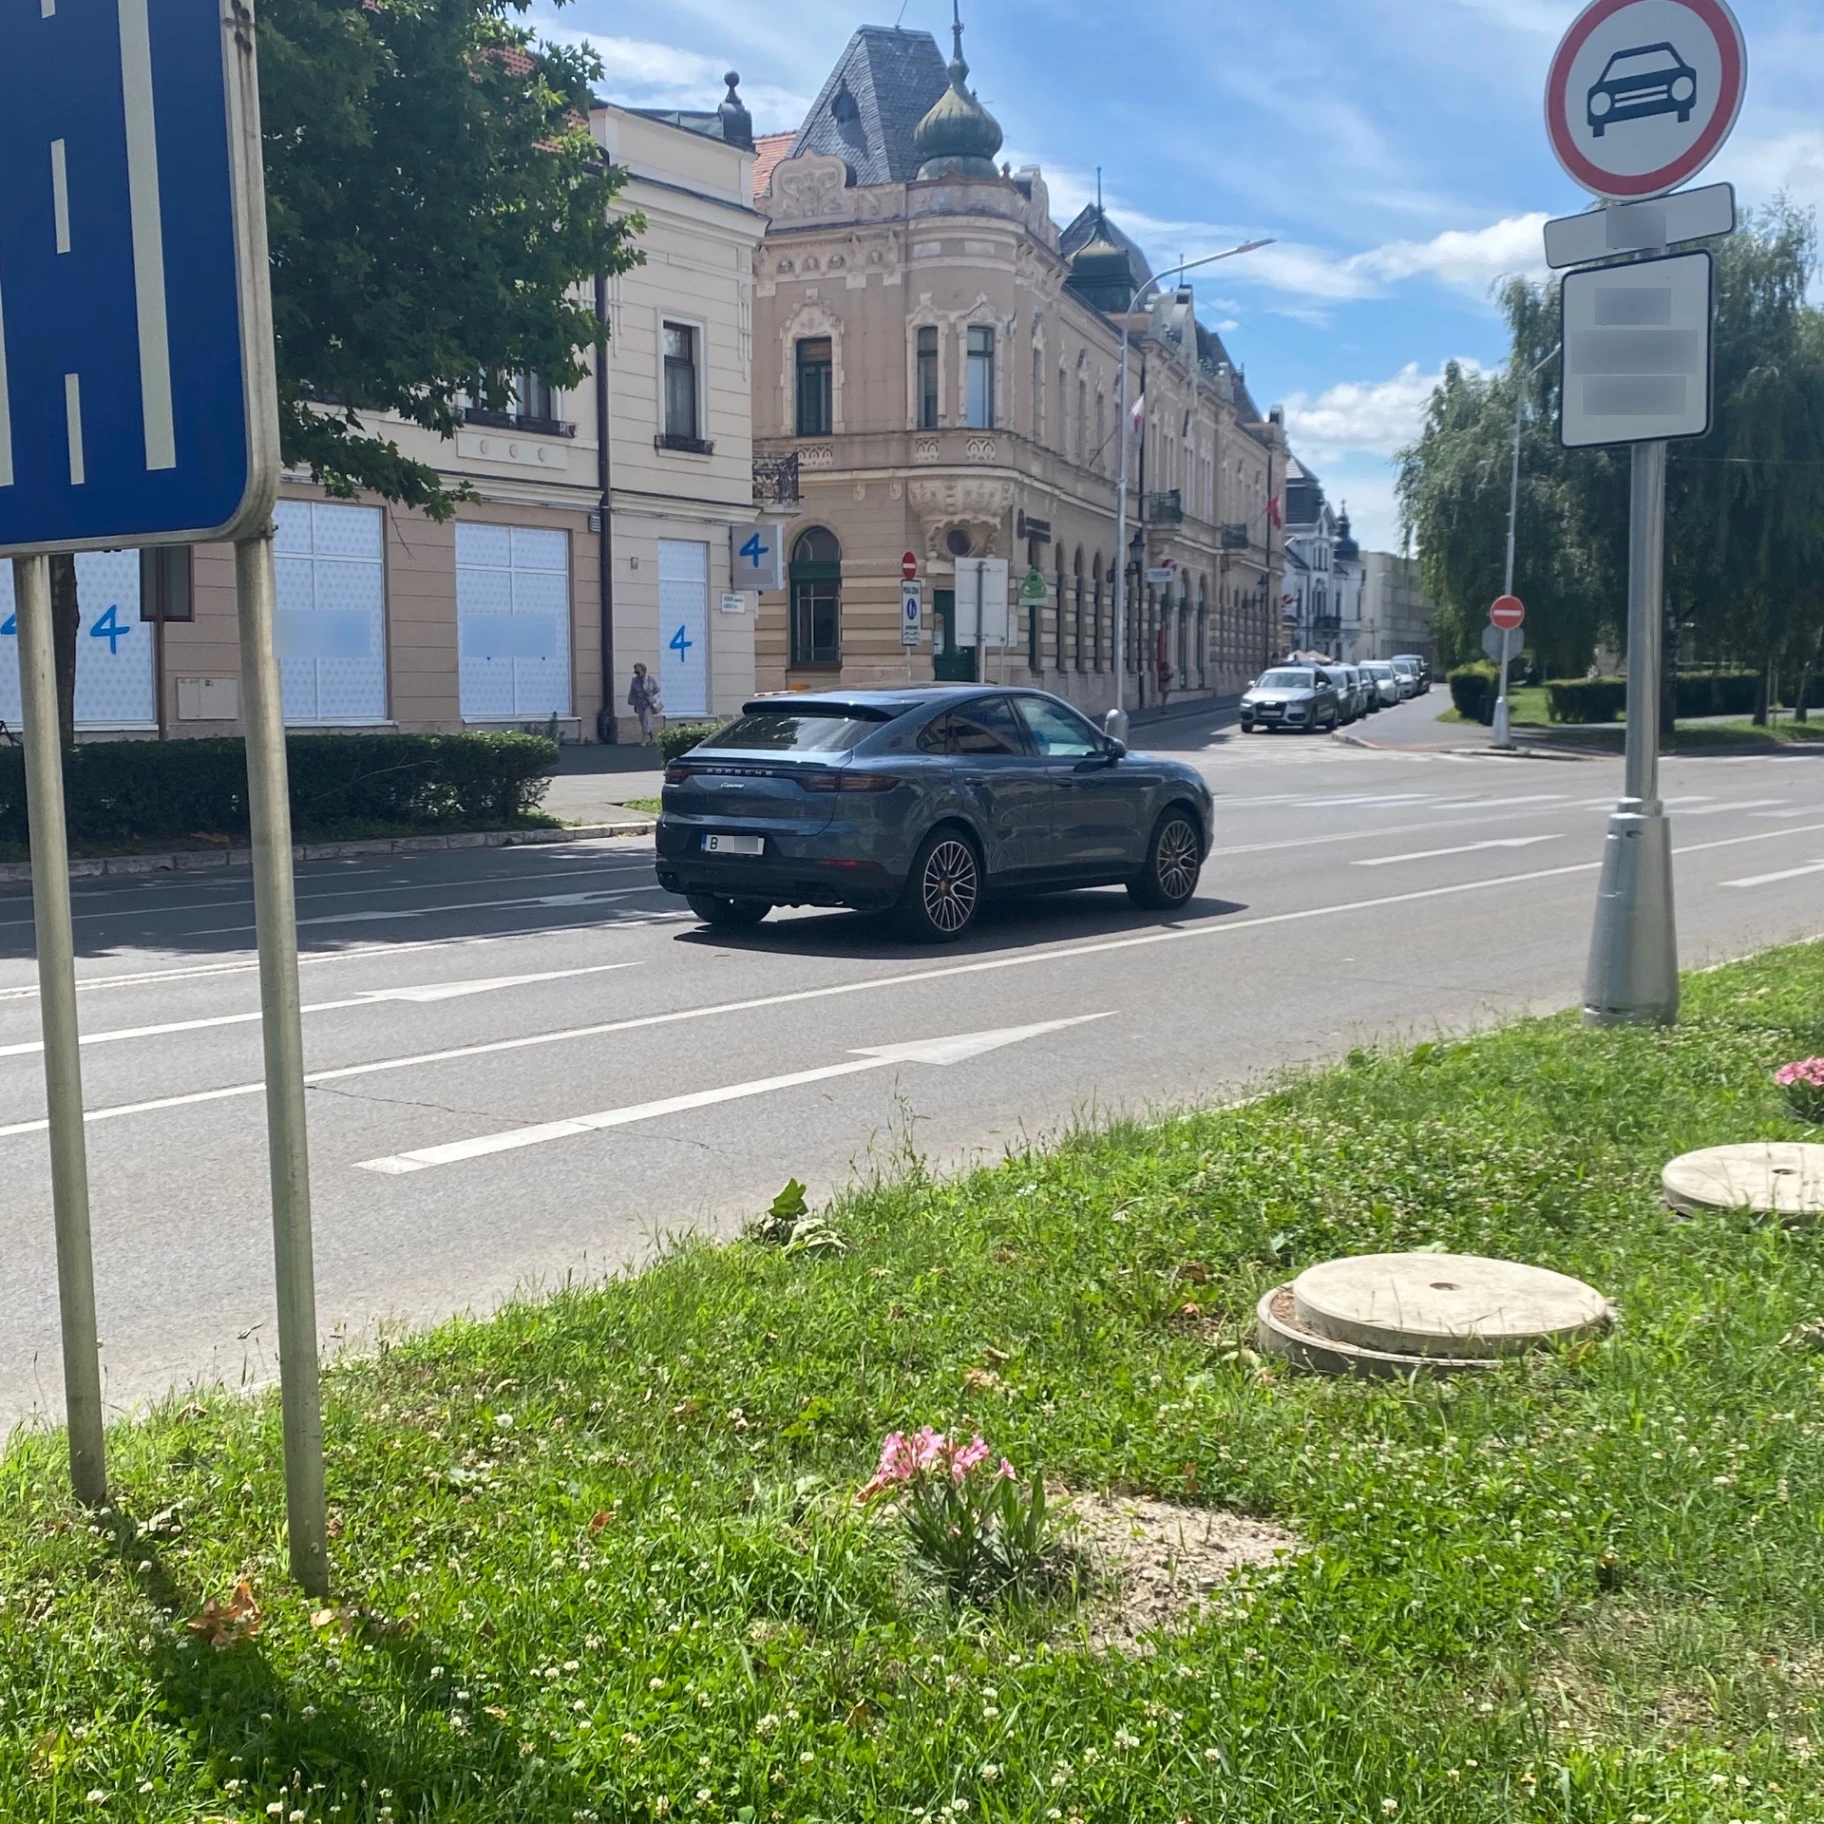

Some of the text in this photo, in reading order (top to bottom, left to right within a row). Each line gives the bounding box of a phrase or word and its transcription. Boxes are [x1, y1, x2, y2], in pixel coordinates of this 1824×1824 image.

[739, 532, 769, 568] 4
[89, 604, 131, 655] 4
[669, 624, 693, 663] 4
